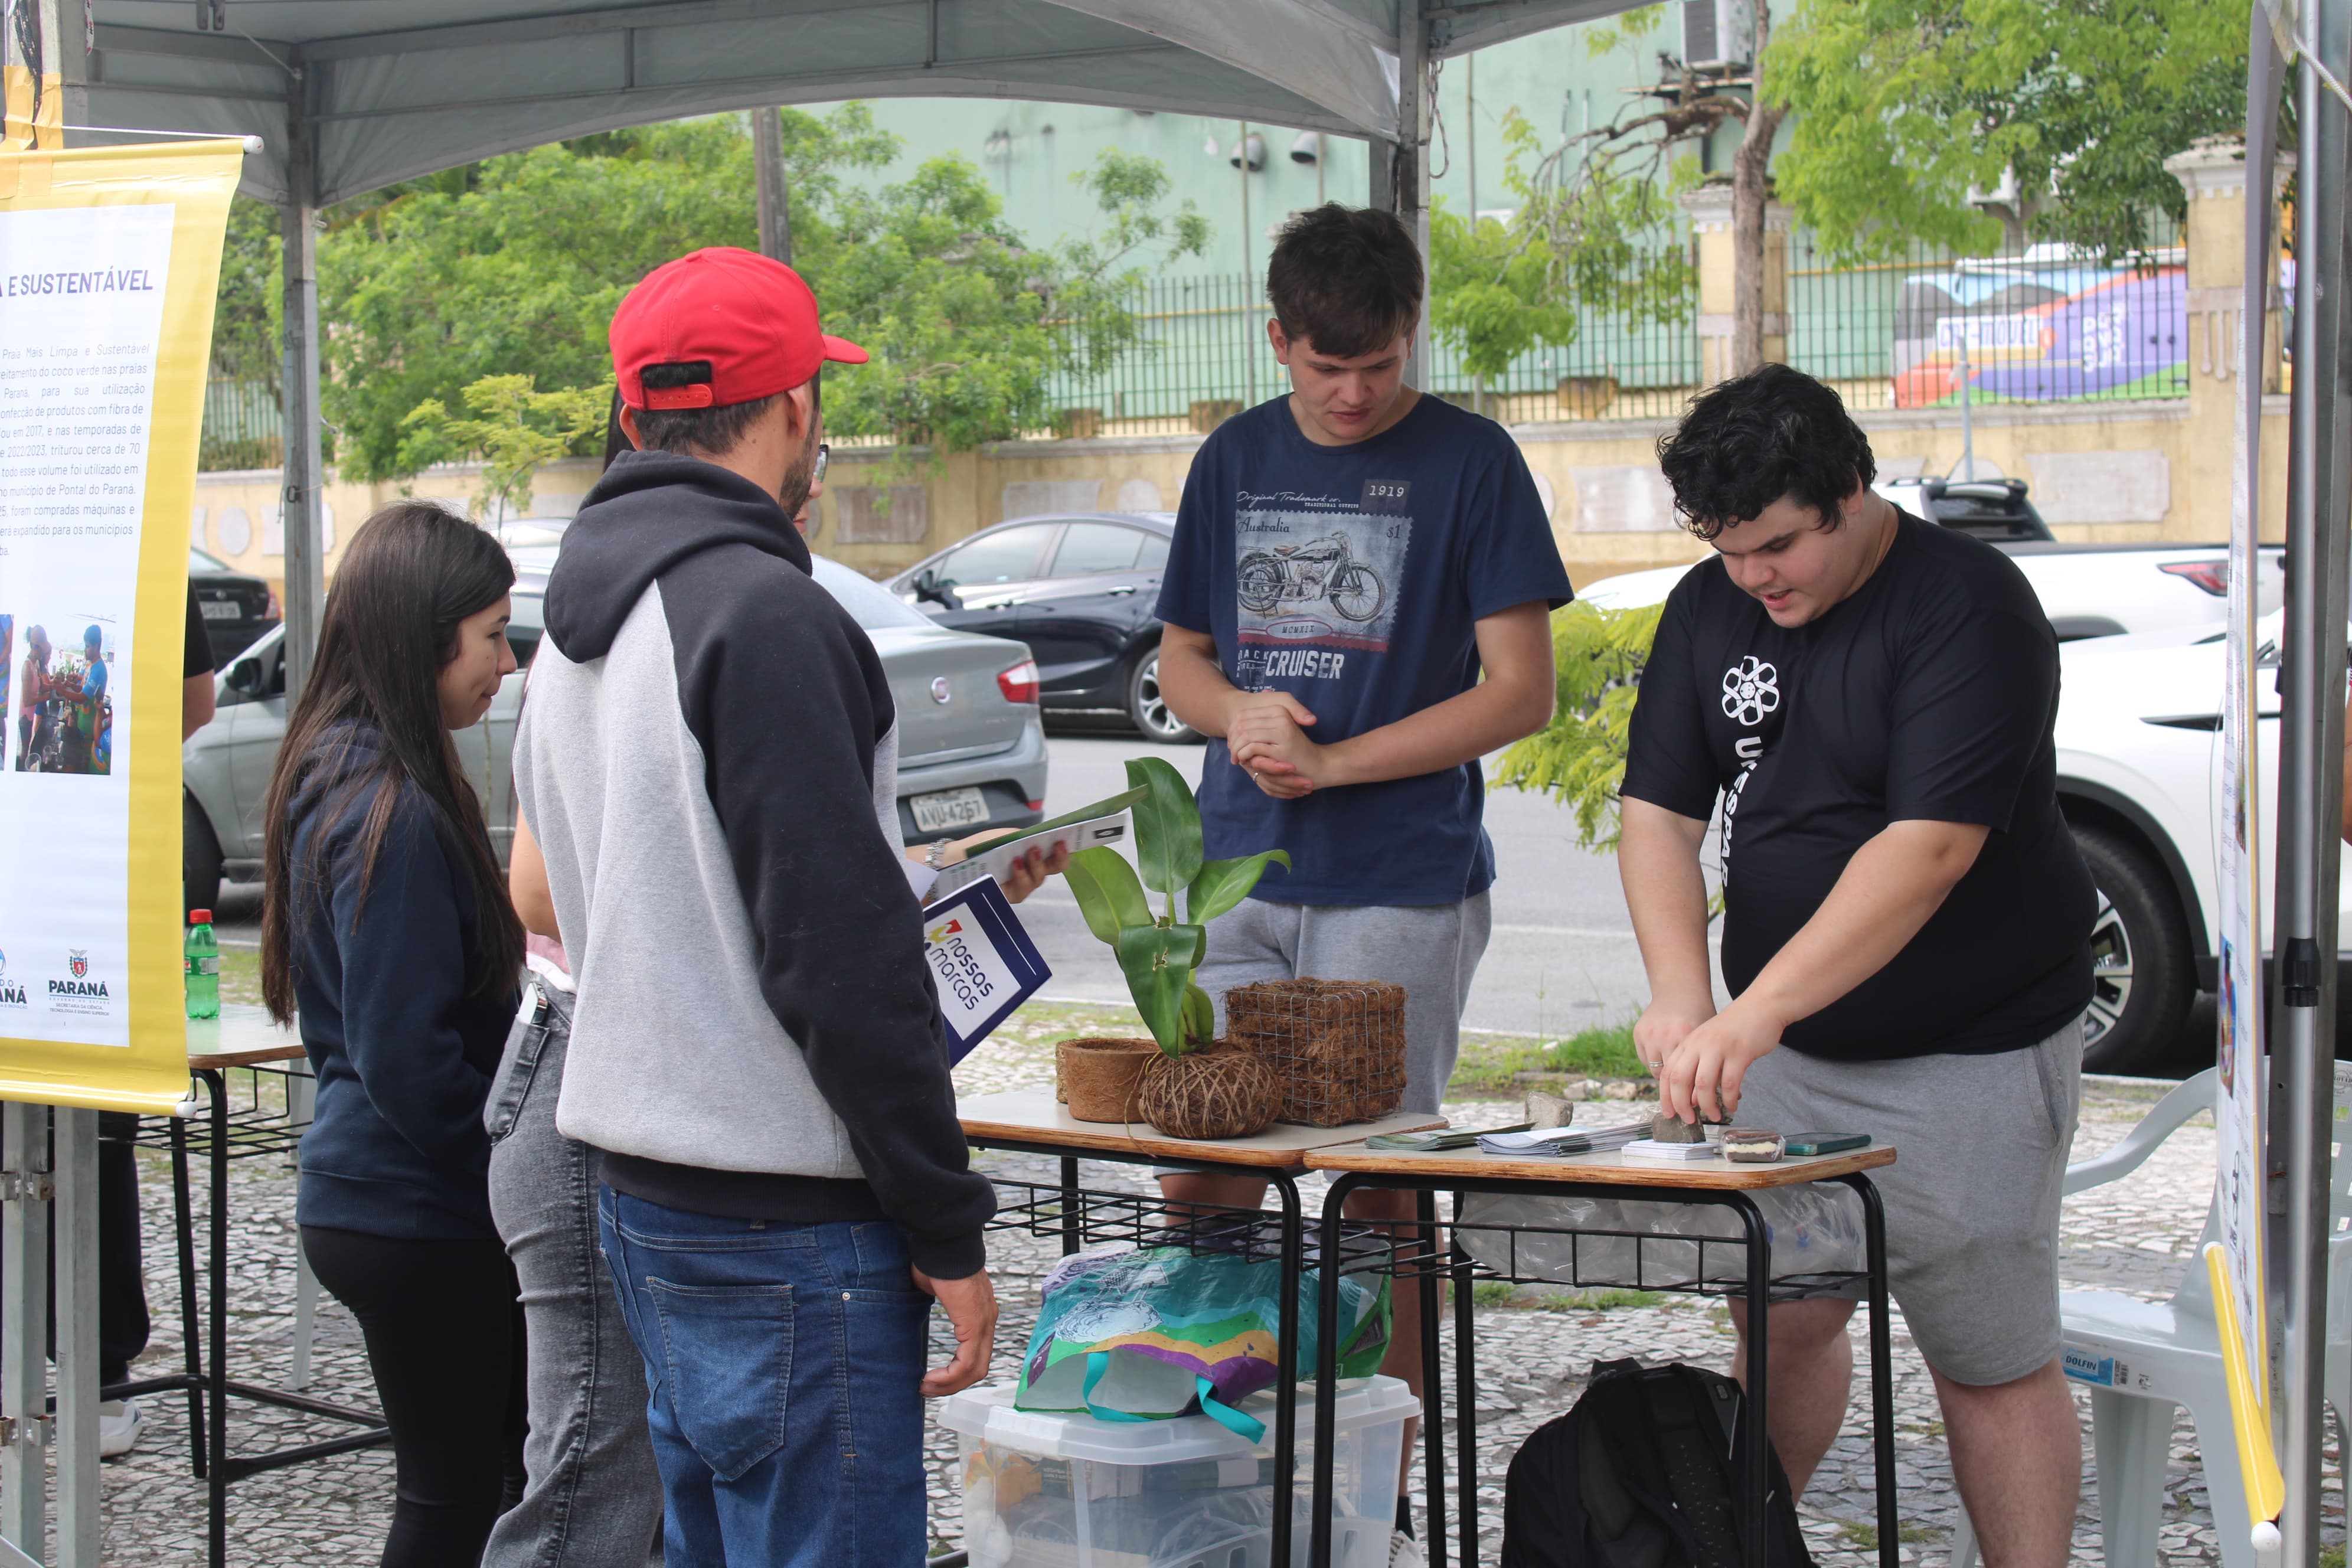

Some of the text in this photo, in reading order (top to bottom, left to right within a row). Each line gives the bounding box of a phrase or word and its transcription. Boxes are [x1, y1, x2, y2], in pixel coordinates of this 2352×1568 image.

[8, 265, 153, 297] E SUSTENTÁVEL
[2, 342, 150, 360] Praia Mais Limpa e Sustentável
[0, 363, 147, 380] eitamento do coco verde nas praias
[41, 387, 60, 399] para
[74, 387, 89, 396] sua
[102, 383, 145, 397] utilização
[35, 406, 45, 417] de
[47, 404, 86, 419] produtos
[87, 406, 107, 416] com
[109, 403, 130, 415] fibra
[132, 403, 143, 414] de
[13, 429, 24, 438] em
[47, 427, 53, 436] e
[55, 426, 70, 436] nas
[74, 423, 127, 437] temporadas
[130, 423, 142, 435] de
[51, 445, 83, 456] triturou
[86, 445, 111, 455] cerca
[115, 443, 126, 455] de
[129, 443, 141, 454] 70
[19, 467, 36, 476] esse
[38, 465, 68, 476] volume
[70, 463, 82, 475] foi
[84, 463, 121, 475] utilizado
[124, 465, 138, 475] em
[9, 485, 44, 498] município
[46, 485, 56, 495] de
[58, 484, 86, 495] Pontal
[89, 484, 100, 495] do
[103, 483, 136, 495] Paraná.
[1369, 485, 1404, 497] 1919
[1237, 491, 1279, 508] Original
[1279, 491, 1327, 502] Trademark
[11, 505, 31, 517] foram
[34, 504, 80, 518] compradas
[83, 504, 126, 518] máquinas
[129, 505, 135, 515] e
[13, 524, 50, 538] expandido
[52, 526, 71, 537] para
[73, 525, 83, 535] os
[85, 524, 133, 537] municípios
[1237, 517, 1290, 533] Australia
[1387, 524, 1401, 538] $1
[1282, 625, 1315, 633] MCMXIX
[1265, 650, 1345, 679] CRUISER
[947, 937, 994, 997] nossas
[929, 948, 979, 1010] marcas
[48, 981, 109, 997] PARANÁ
[2066, 1355, 2096, 1370] DOLFIN
